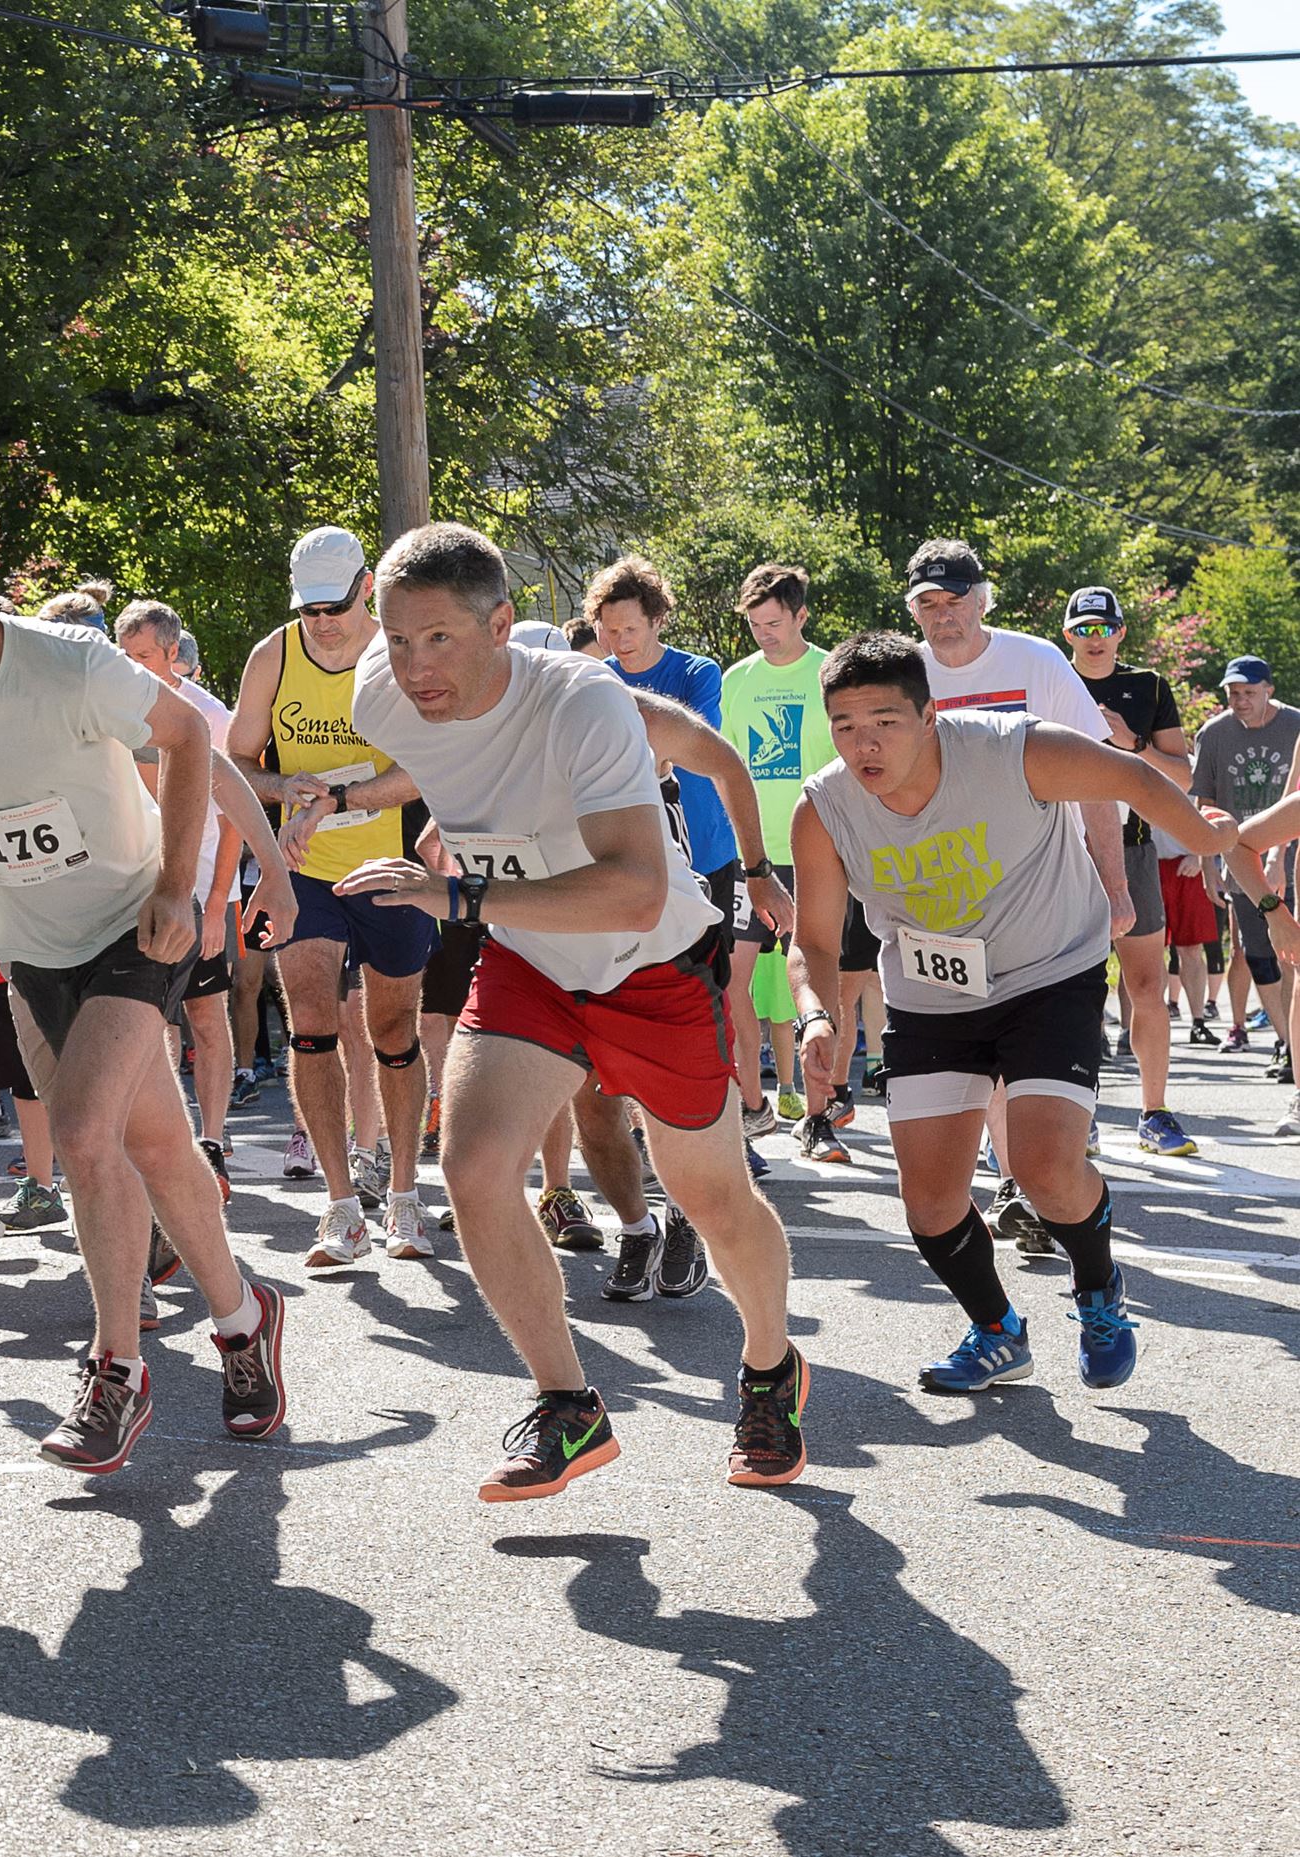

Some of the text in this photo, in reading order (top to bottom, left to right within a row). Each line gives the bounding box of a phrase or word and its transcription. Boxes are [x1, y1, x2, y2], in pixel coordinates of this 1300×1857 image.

[782, 693, 806, 701] school
[297, 734, 329, 745] ROAD
[1227, 745, 1289, 775] BOSTON
[750, 766, 800, 777] ROAD RACE
[870, 821, 991, 886] EVERY
[914, 949, 969, 986] 188
